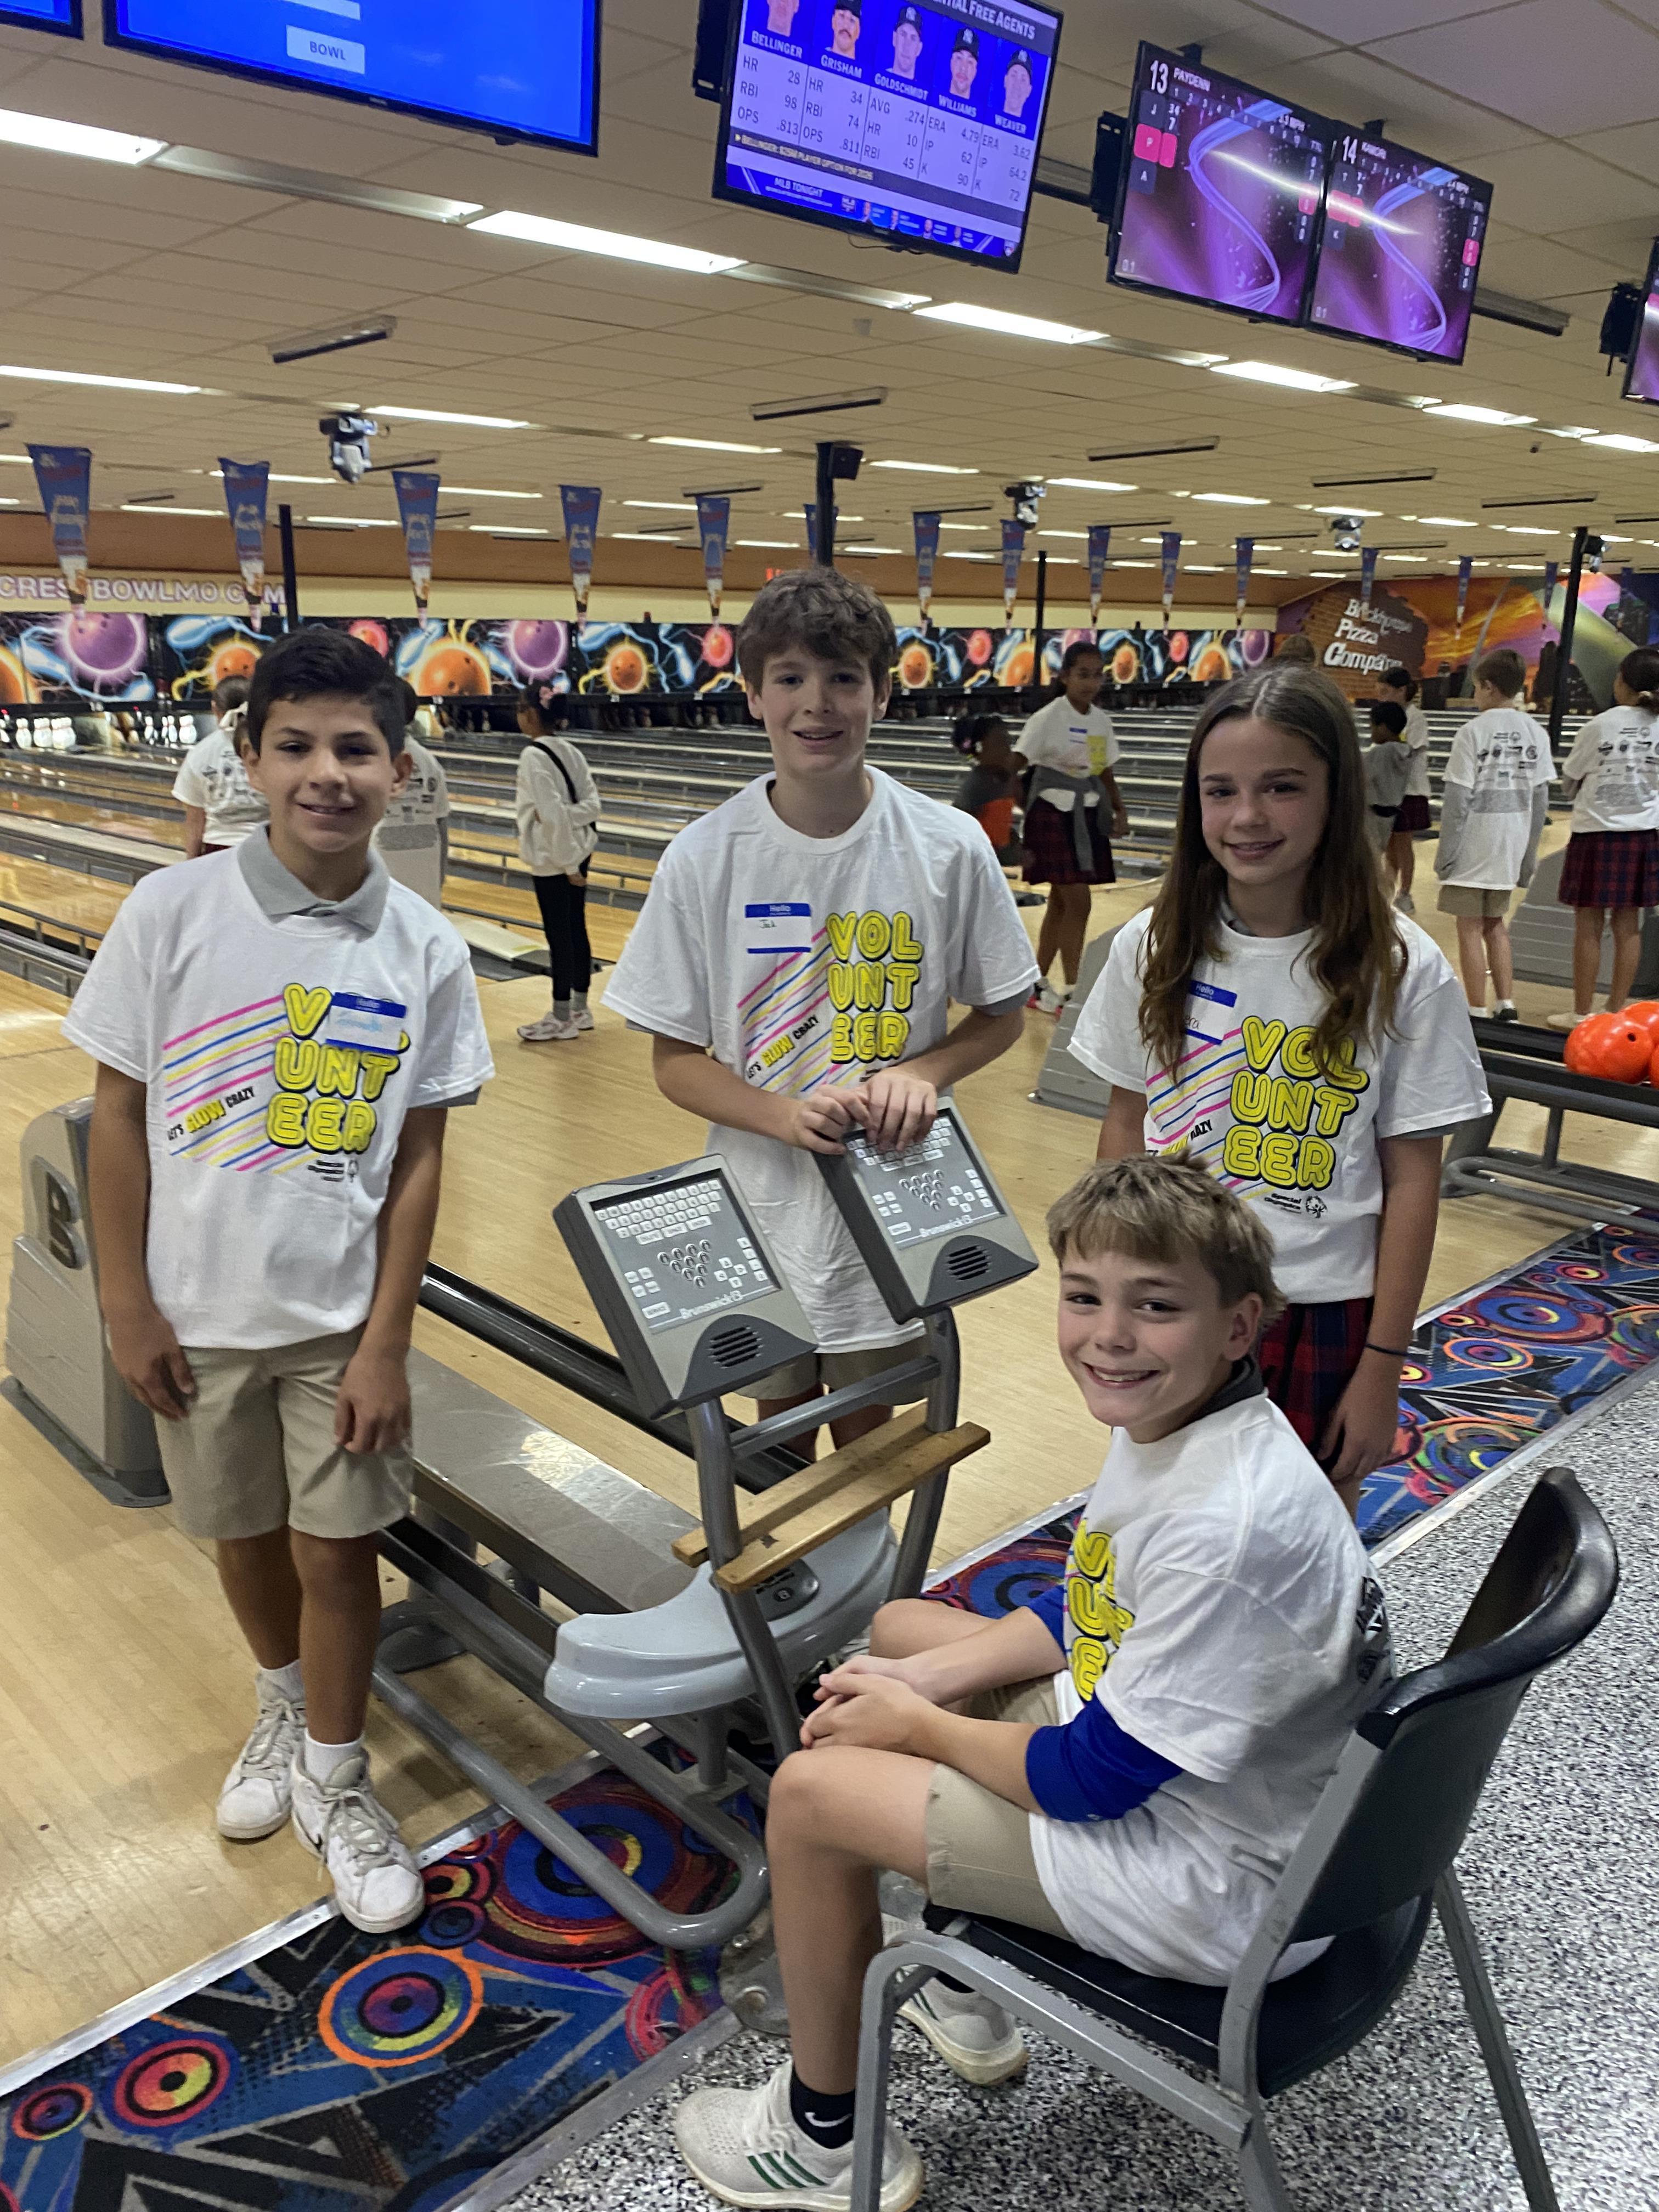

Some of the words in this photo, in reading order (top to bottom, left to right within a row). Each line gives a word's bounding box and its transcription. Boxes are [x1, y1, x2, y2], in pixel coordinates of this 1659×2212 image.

[968, 1, 996, 24] FREE
[995, 12, 1036, 40] AGENTS
[309, 41, 346, 61] BOWL
[752, 30, 803, 59] BELLINGER
[743, 55, 758, 71] HR
[788, 70, 800, 84] 28
[821, 55, 862, 78] GRISHAM
[1150, 60, 1169, 94] 13
[741, 81, 758, 98] RBI
[785, 95, 797, 109] 98
[809, 77, 823, 93] HR
[850, 91, 862, 104] 34
[874, 73, 928, 101] GOLDSCHMIDT
[737, 106, 759, 123] OPS
[806, 101, 822, 117] RBI
[848, 115, 859, 128] 74
[870, 98, 890, 114] AVG
[939, 94, 977, 117] WILLIAMS
[803, 126, 823, 142] OPS
[867, 121, 881, 136] HR
[907, 134, 918, 148] 10
[928, 116, 946, 133] ERA
[995, 114, 1026, 134] WEAVER
[925, 139, 934, 151] IP
[961, 152, 972, 165] 62
[982, 134, 999, 149] ERA
[1343, 136, 1357, 163] 14
[864, 145, 880, 160] RBI
[902, 157, 914, 170] 45
[979, 157, 988, 169] IP
[774, 177, 791, 189] MLB
[792, 182, 823, 198] TONIGHT
[921, 162, 927, 174] K
[957, 173, 969, 186] 90
[975, 179, 981, 190] K
[1009, 189, 1020, 202] 72
[1334, 618, 1379, 645] Pizza
[825, 910, 924, 963] VOL
[827, 961, 921, 1013] UNT
[1195, 984, 1214, 995] Hello
[792, 1015, 821, 1040] CRAZY
[830, 1011, 910, 1064] EER
[1241, 1015, 1370, 1093] VOL
[273, 1036, 400, 1103] UNT
[185, 1099, 226, 1133] GLOW
[225, 1086, 255, 1108] CRAZY
[1230, 1070, 1359, 1138] UNT
[266, 1092, 377, 1154] EER
[1222, 1124, 1336, 1191] EER
